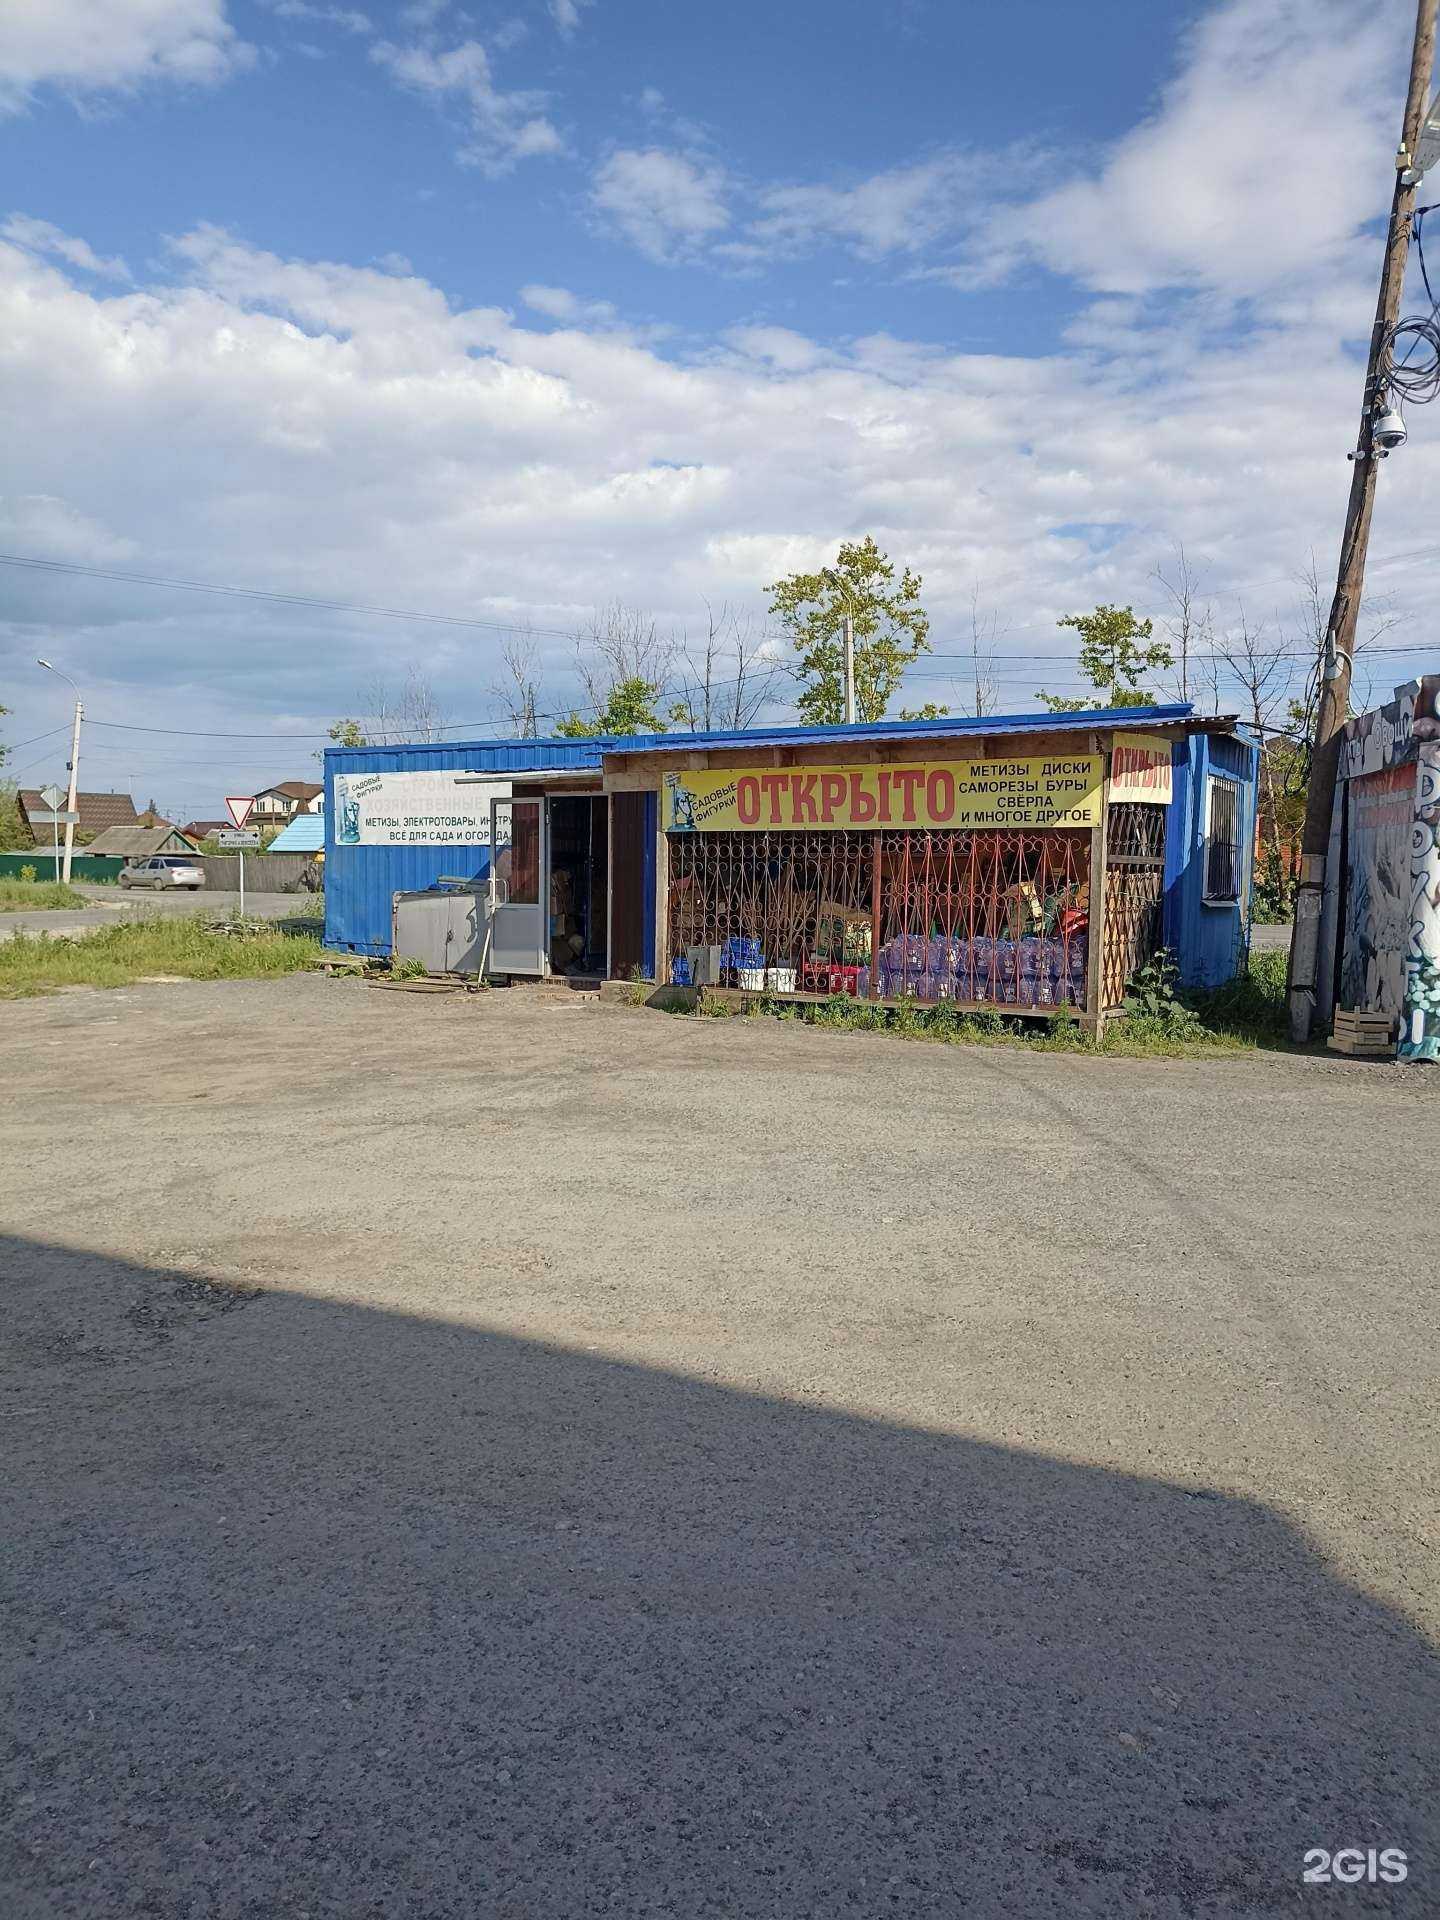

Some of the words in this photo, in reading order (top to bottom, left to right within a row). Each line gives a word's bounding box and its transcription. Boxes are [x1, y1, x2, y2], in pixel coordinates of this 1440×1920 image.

[970, 764, 1029, 777] МЕТИЗЫ
[1041, 762, 1091, 776] ДИСКИ
[1113, 747, 1170, 790] ОТКРЫТО
[356, 783, 383, 799] ФИГУРКИ
[959, 781, 1039, 793] САМОРЕЗЫ
[1046, 779, 1087, 792] БУРЫ
[692, 781, 737, 811] САДОВЫЕ
[737, 769, 955, 825] ОТКРЫТО
[997, 794, 1054, 808] СВЁРЛА
[695, 796, 737, 822] ФИГУРКИ
[961, 812, 970, 823] И
[974, 810, 1032, 822] МНОГОЕ
[1036, 809, 1091, 823] ДРУГОЕ
[365, 817, 401, 828] МЕТИЗЫ,
[403, 816, 477, 828] ЭЛЕКТРОТОВАРЫ,
[409, 831, 427, 842] ДЛЯ
[430, 831, 454, 842] САДА
[456, 831, 463, 840] И
[465, 831, 509, 842] ОГОРДА
